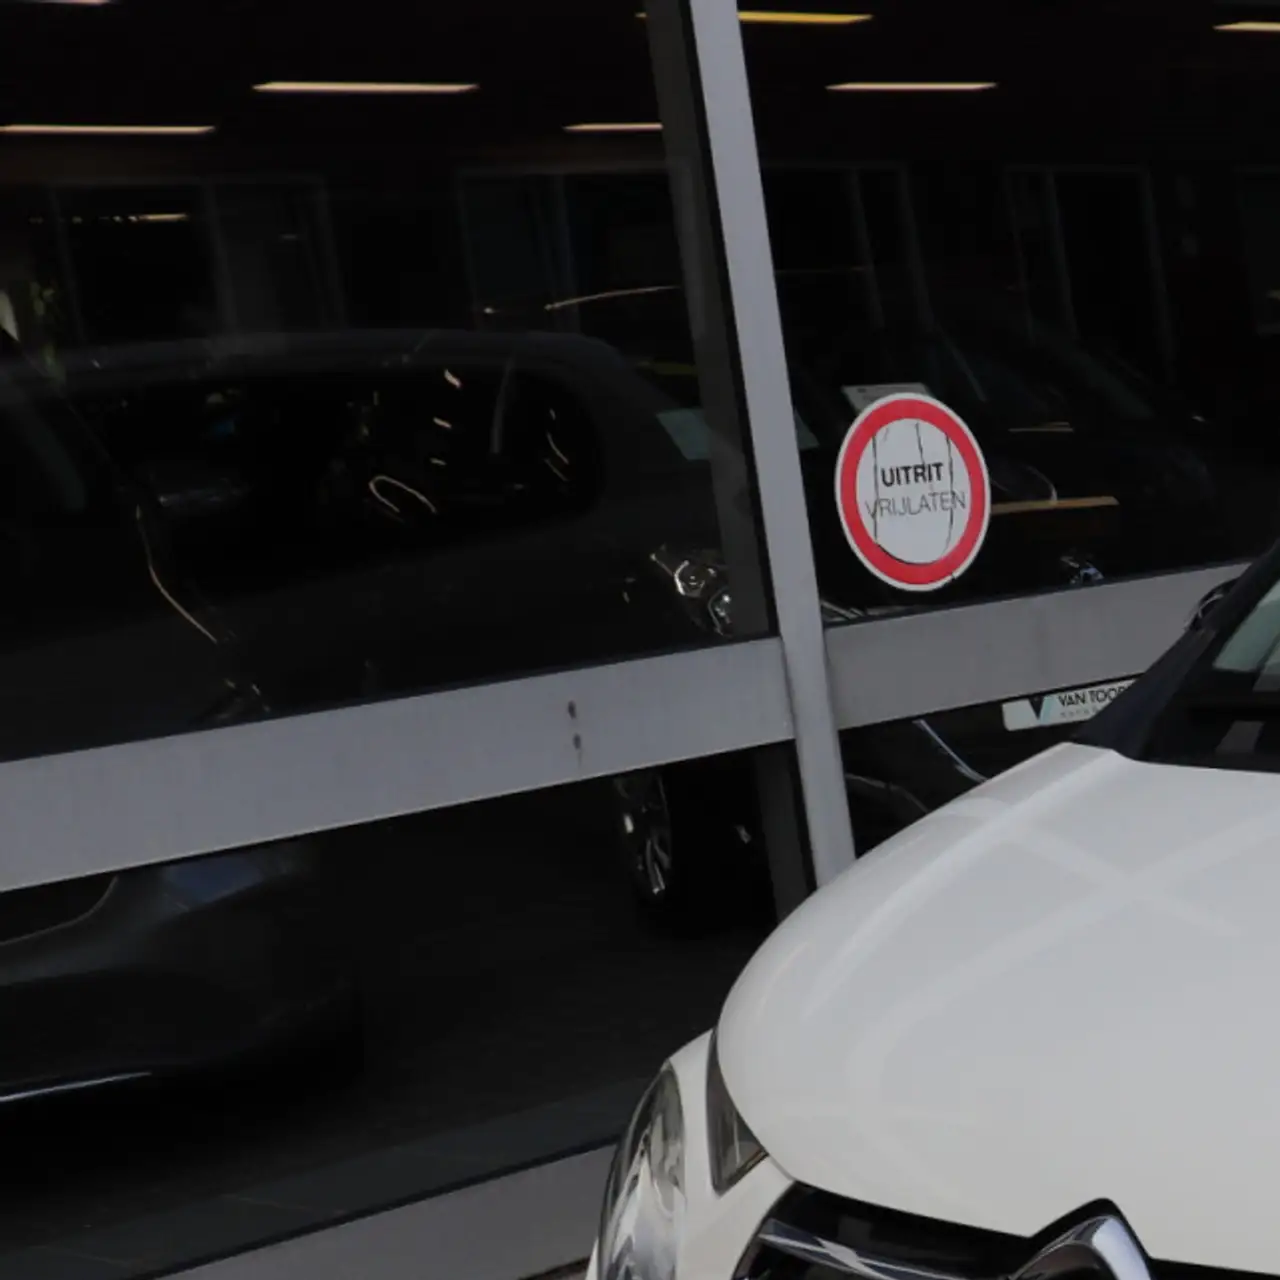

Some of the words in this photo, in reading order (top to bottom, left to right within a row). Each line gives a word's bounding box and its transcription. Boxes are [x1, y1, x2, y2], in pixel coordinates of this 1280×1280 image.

[881, 462, 943, 487] UITRIT
[864, 490, 966, 520] VRIJLATEN
[1058, 691, 1086, 706] VAN
